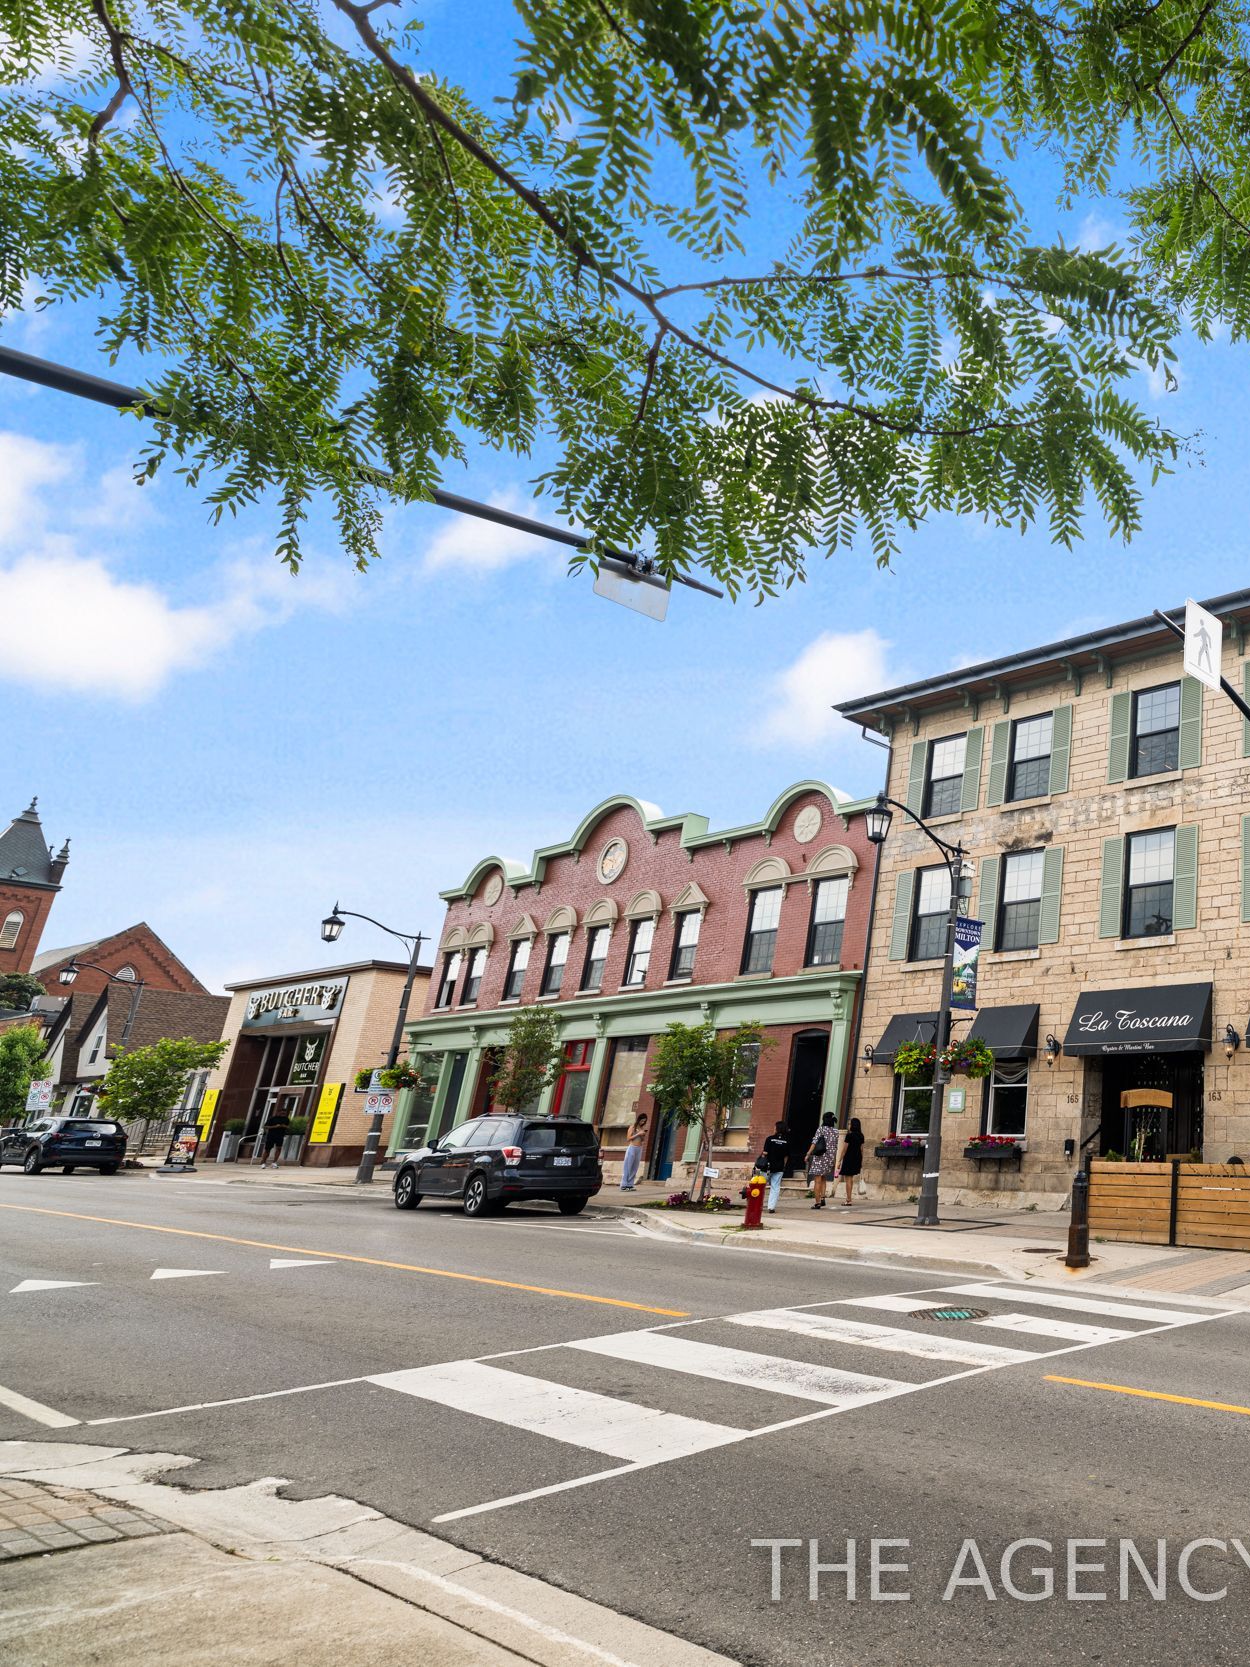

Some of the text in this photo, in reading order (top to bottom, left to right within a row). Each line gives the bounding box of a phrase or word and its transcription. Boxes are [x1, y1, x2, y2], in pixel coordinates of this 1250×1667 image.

[955, 927, 981, 936] DOWNTOWN
[954, 932, 981, 943] MILTON
[259, 985, 321, 1013] BUTCHER
[1078, 1009, 1194, 1032] La Toscana
[1066, 1094, 1079, 1103] 165
[1208, 1092, 1222, 1102] 163
